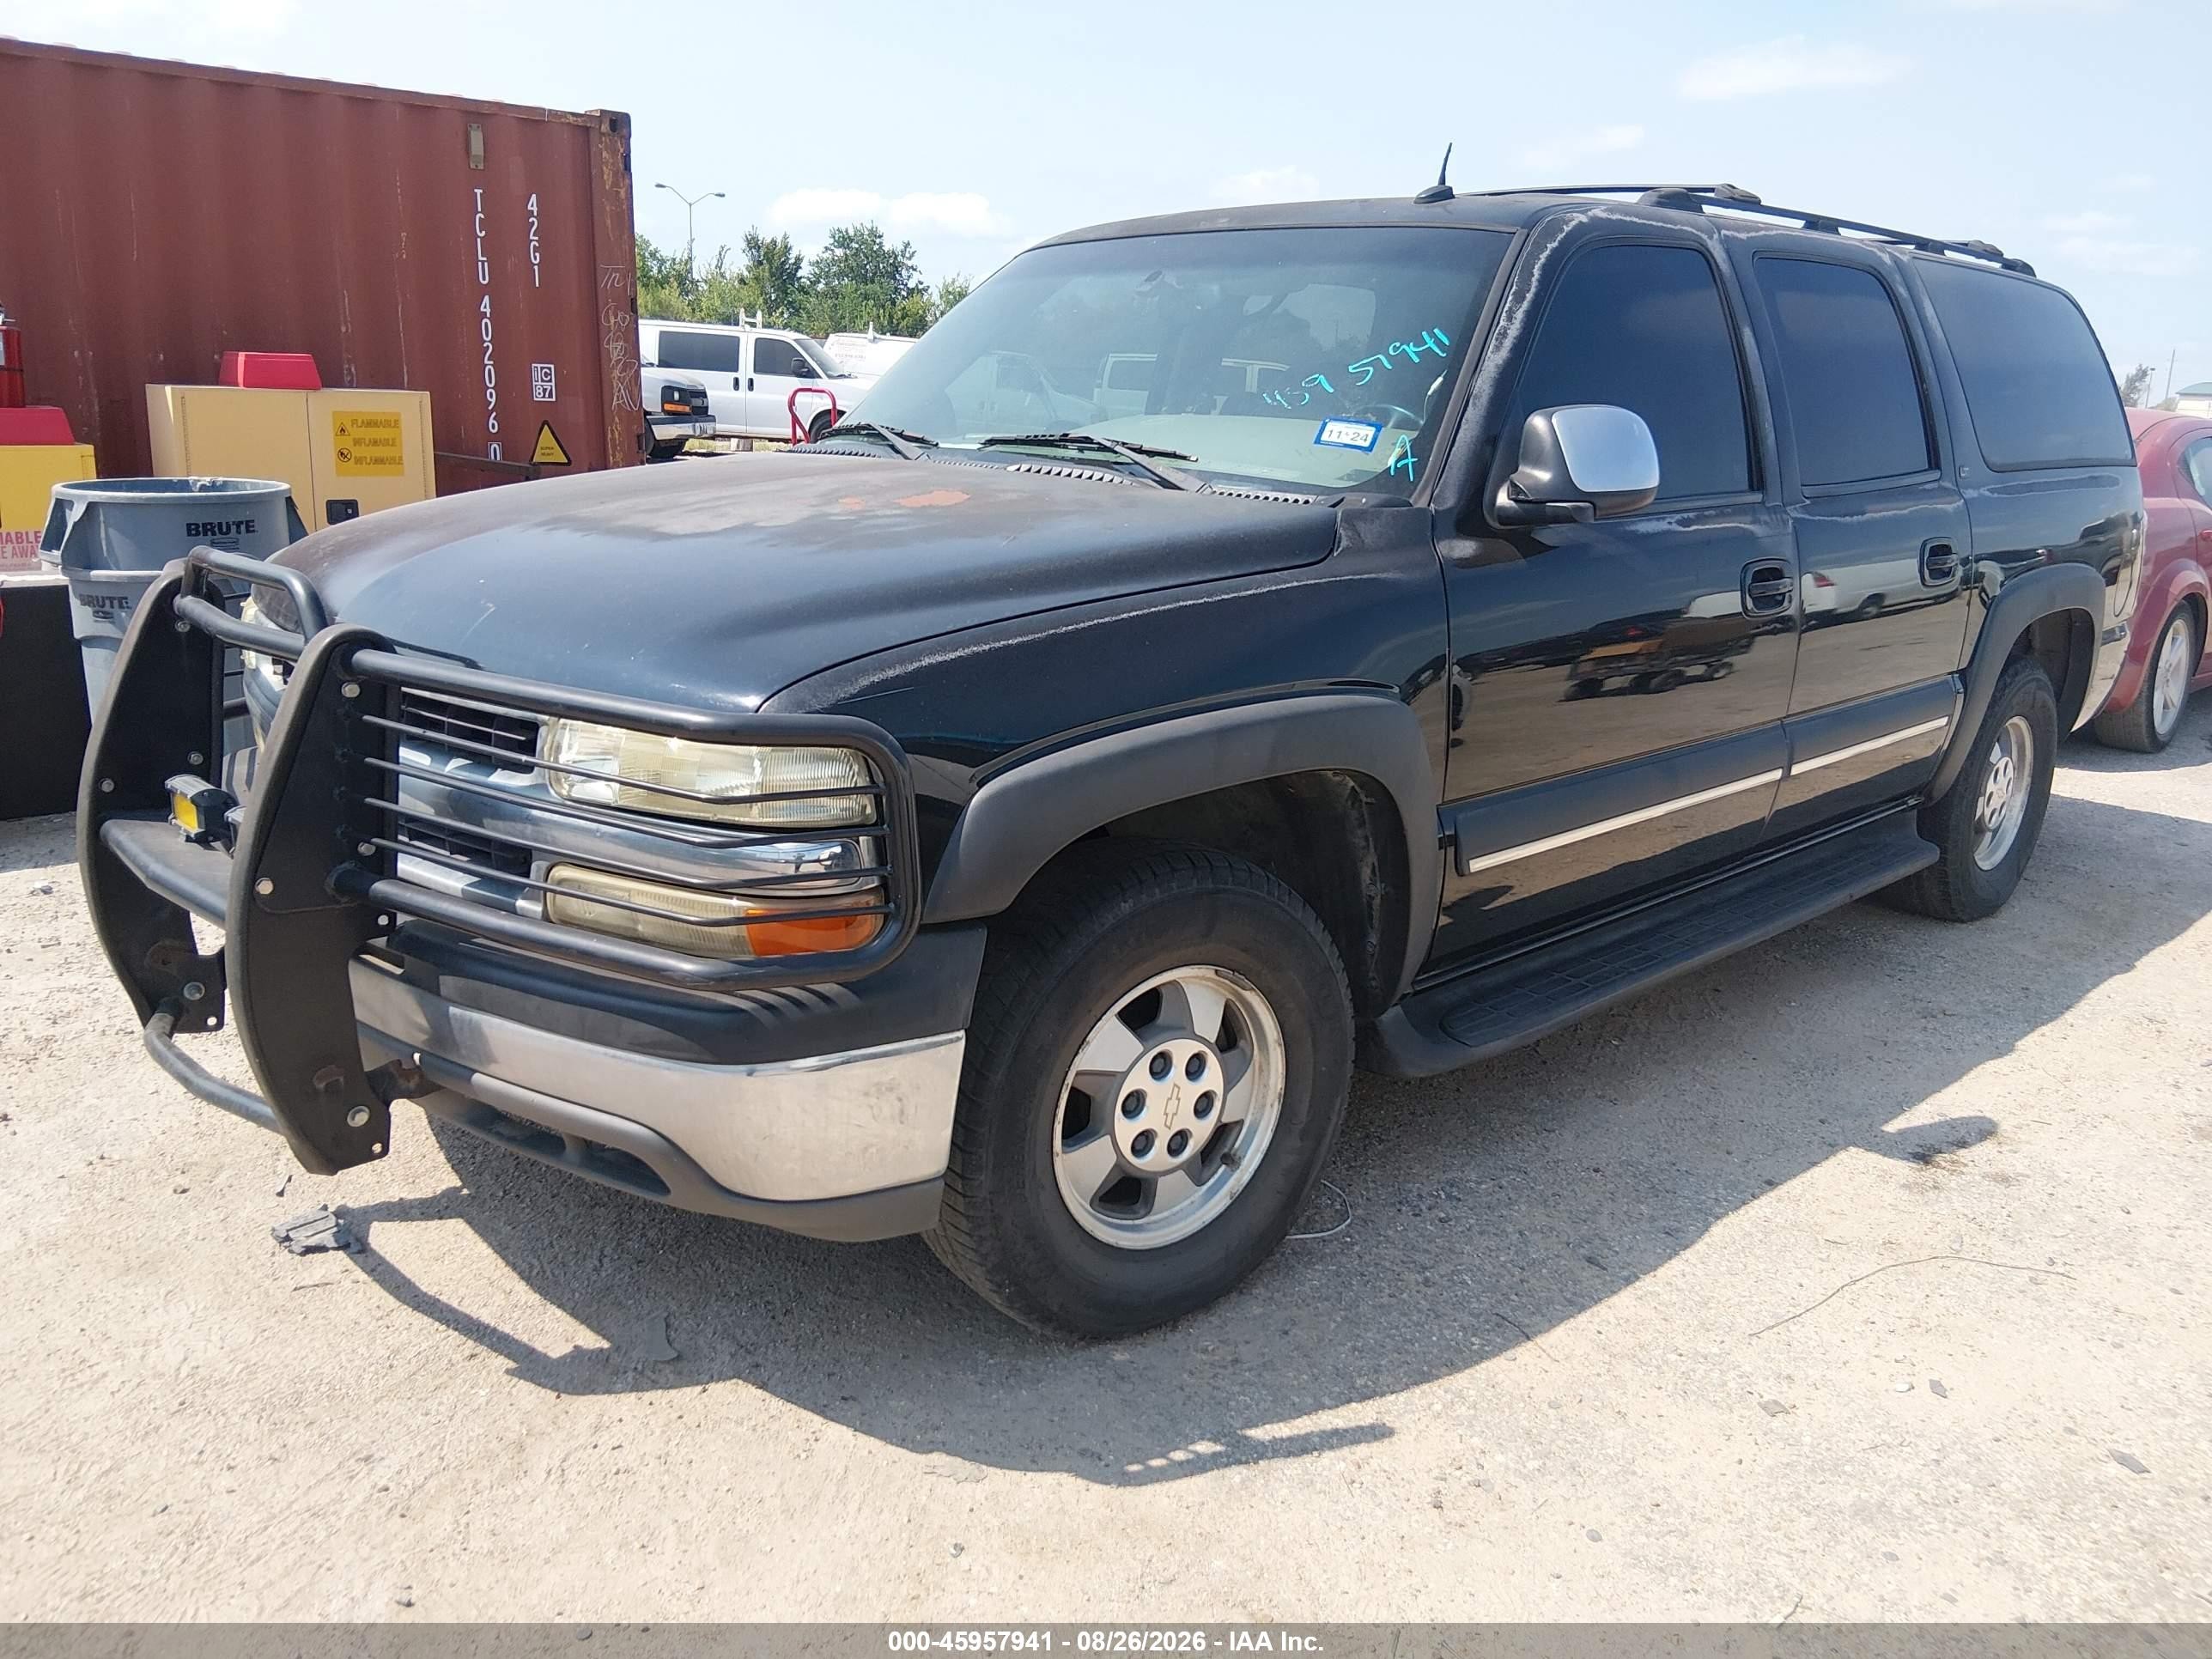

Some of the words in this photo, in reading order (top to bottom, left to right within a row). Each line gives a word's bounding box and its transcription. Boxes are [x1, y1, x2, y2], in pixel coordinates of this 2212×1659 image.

[474, 188, 489, 285] TCLU
[527, 193, 540, 288] 42G1
[480, 295, 499, 434] 402096
[535, 386, 552, 398] 87
[350, 419, 399, 428] FLAMMABLE
[1389, 434, 1418, 482] A
[185, 520, 257, 538] BRUTE
[79, 593, 130, 610] BRUTE
